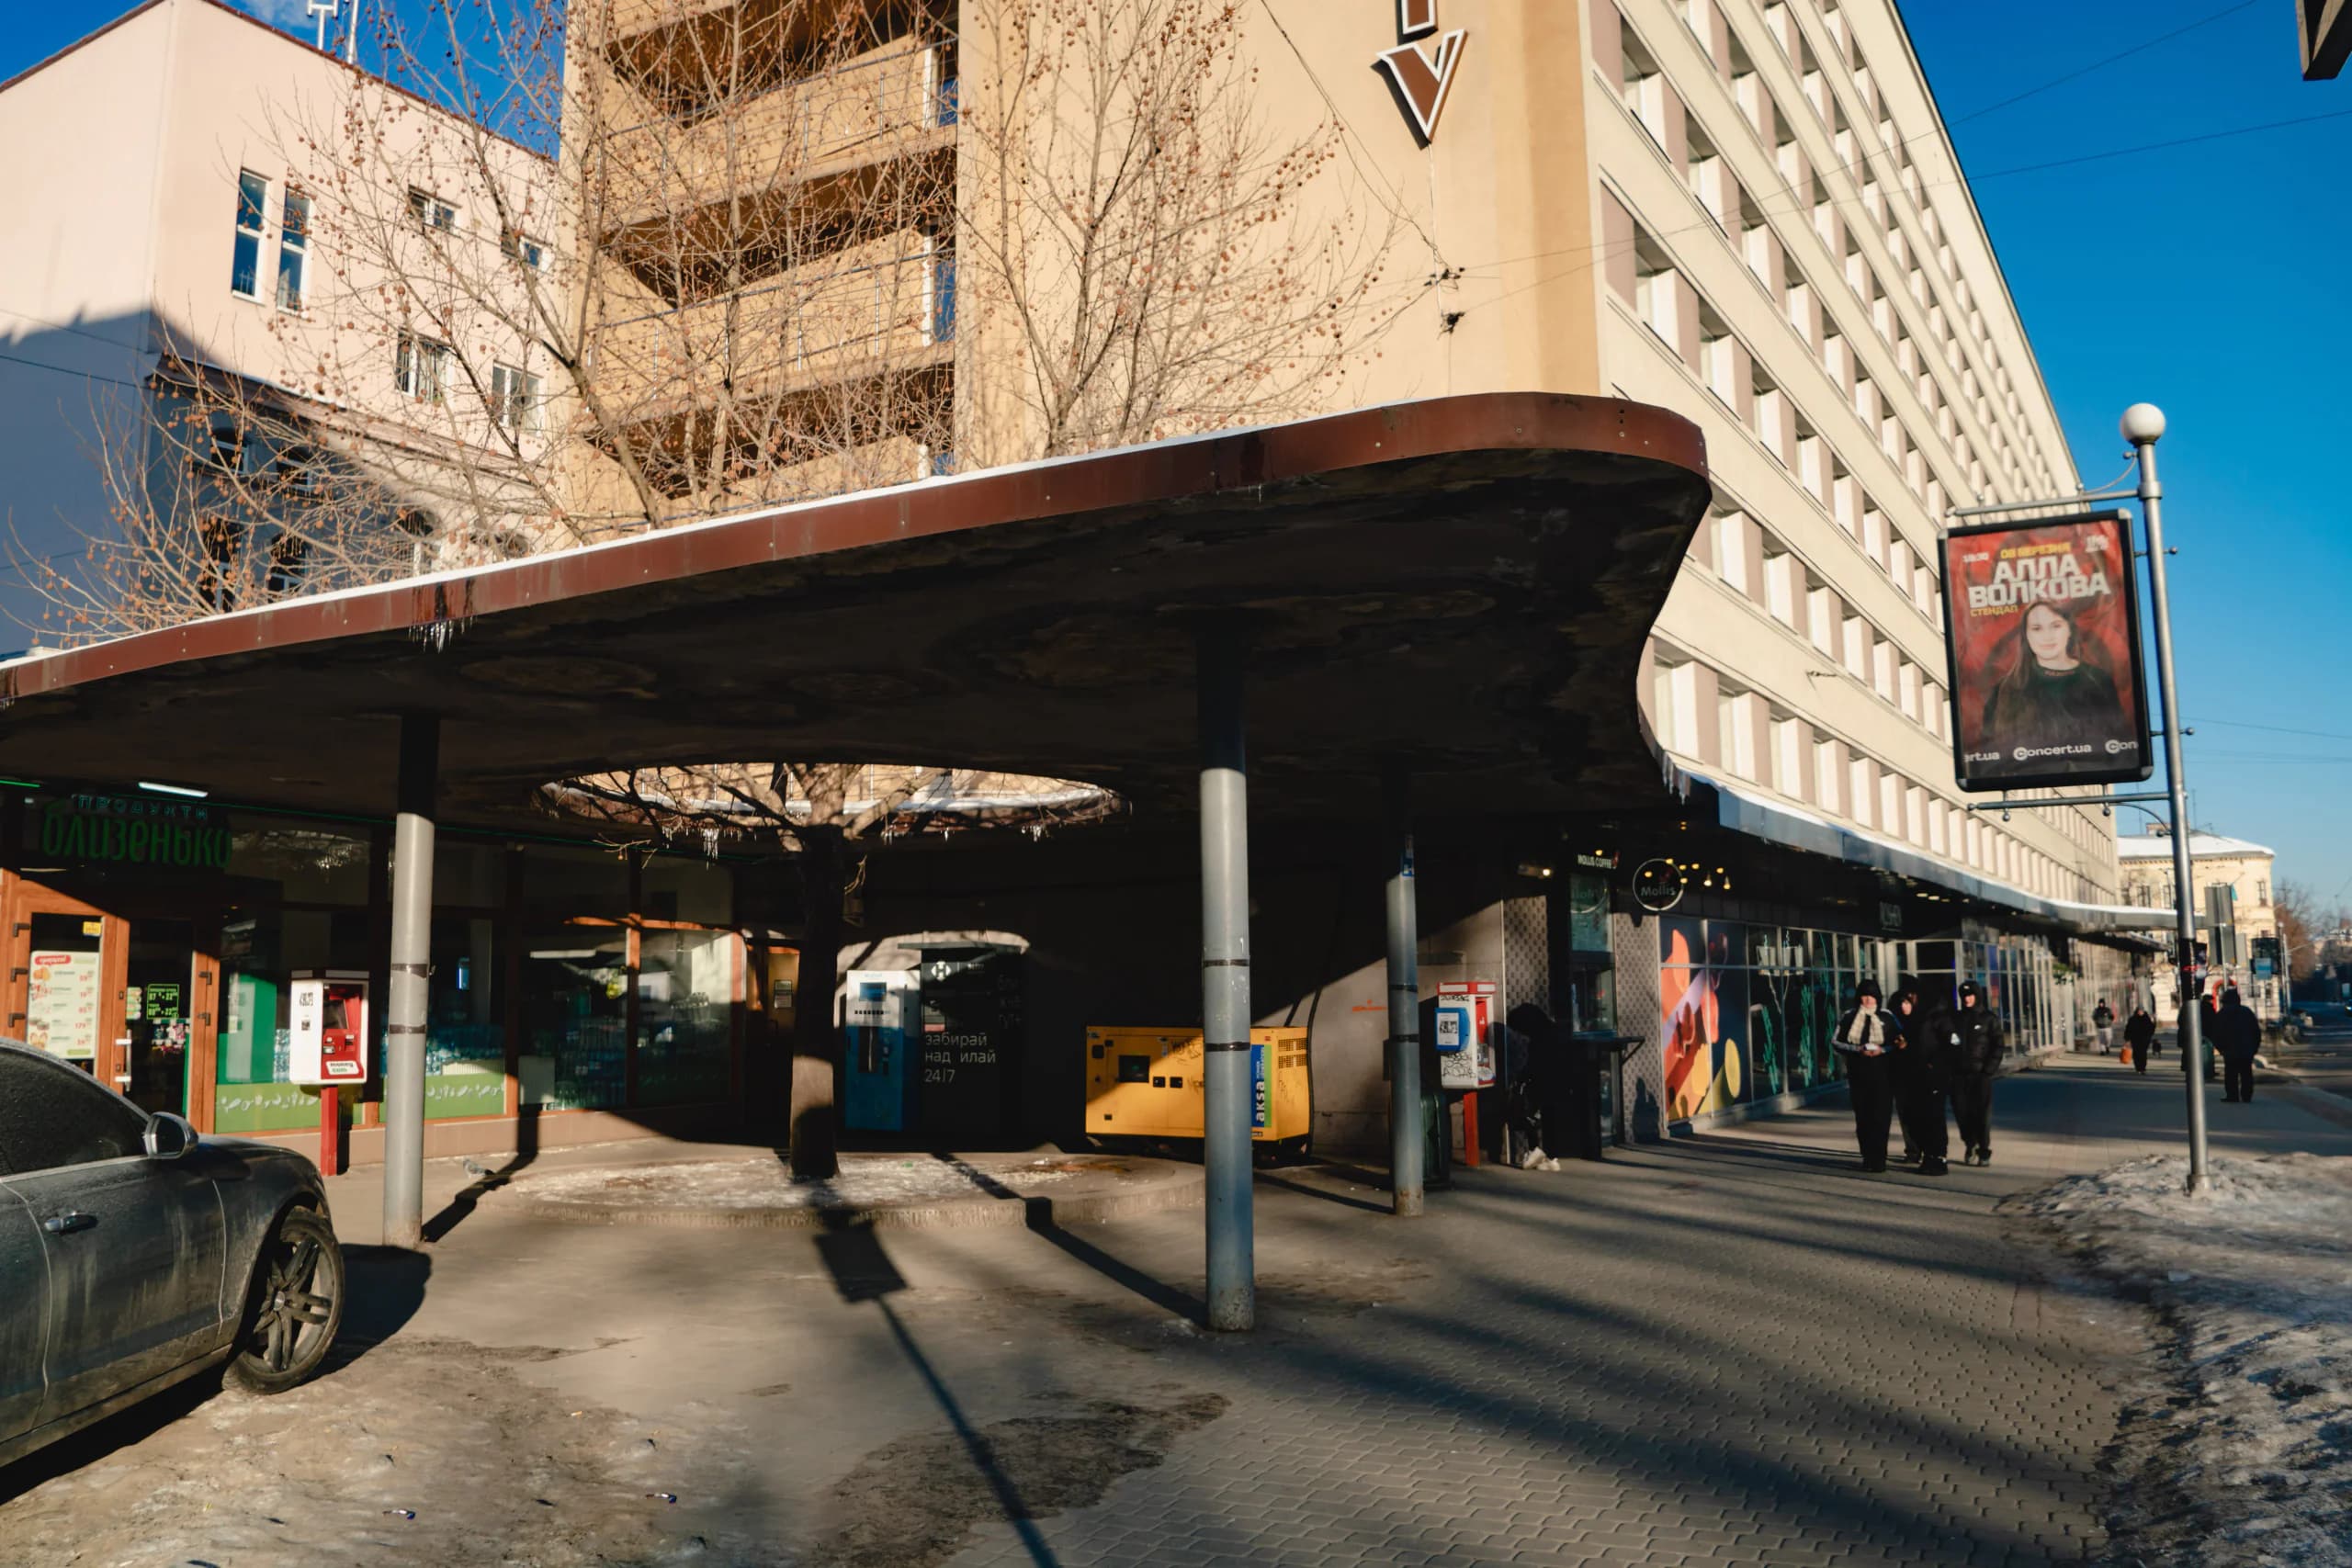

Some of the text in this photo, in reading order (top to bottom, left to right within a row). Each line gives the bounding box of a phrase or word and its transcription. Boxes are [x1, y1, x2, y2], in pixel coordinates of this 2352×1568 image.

[1993, 553, 2082, 585] АЛЛА
[1968, 572, 2111, 608] ВОЛКОВА
[1970, 604, 2018, 617] СТЕНДАП
[2013, 743, 2093, 761] Concert.ua
[77, 795, 208, 819] ПРОДУКТИ
[1640, 885, 1677, 897] Mollis
[925, 1032, 988, 1048] забирай
[1255, 1080, 1265, 1122] aksa
